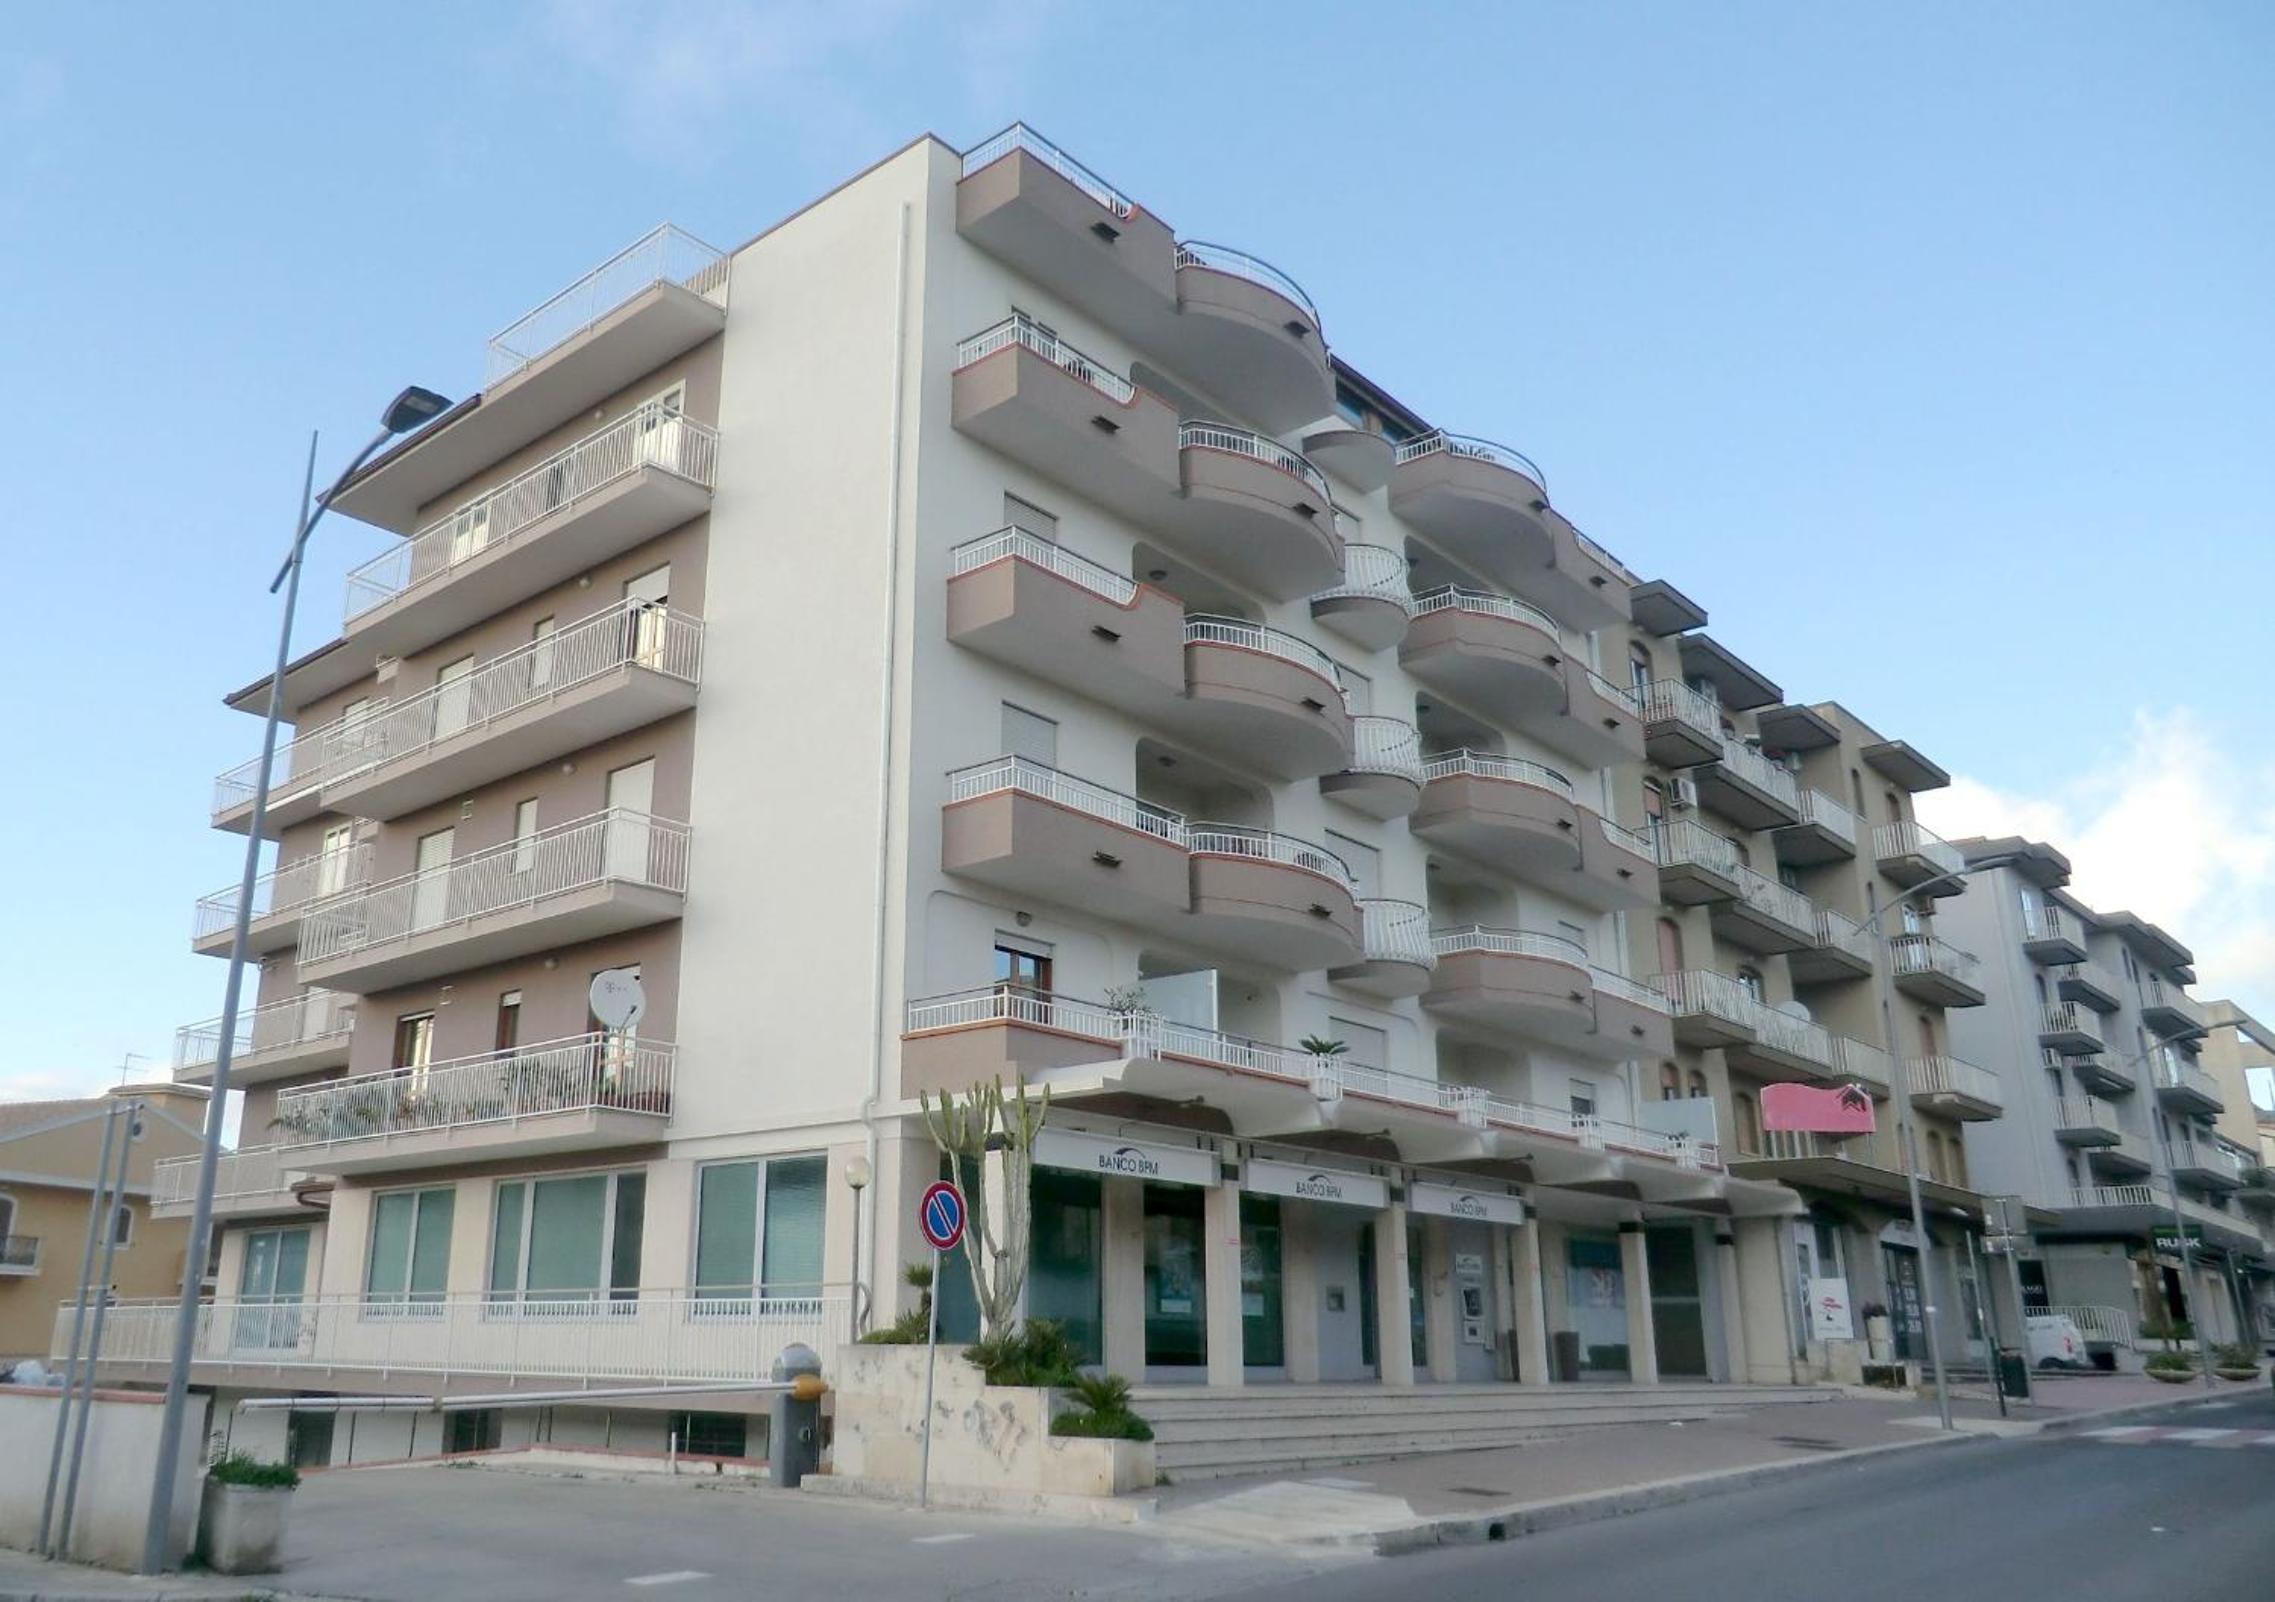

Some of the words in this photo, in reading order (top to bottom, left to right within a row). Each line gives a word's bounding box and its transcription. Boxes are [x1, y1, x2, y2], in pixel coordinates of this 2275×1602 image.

[1098, 1155, 1137, 1172] BANCO
[1138, 1160, 1159, 1176] BPM
[1296, 1182, 1325, 1197] BANCO
